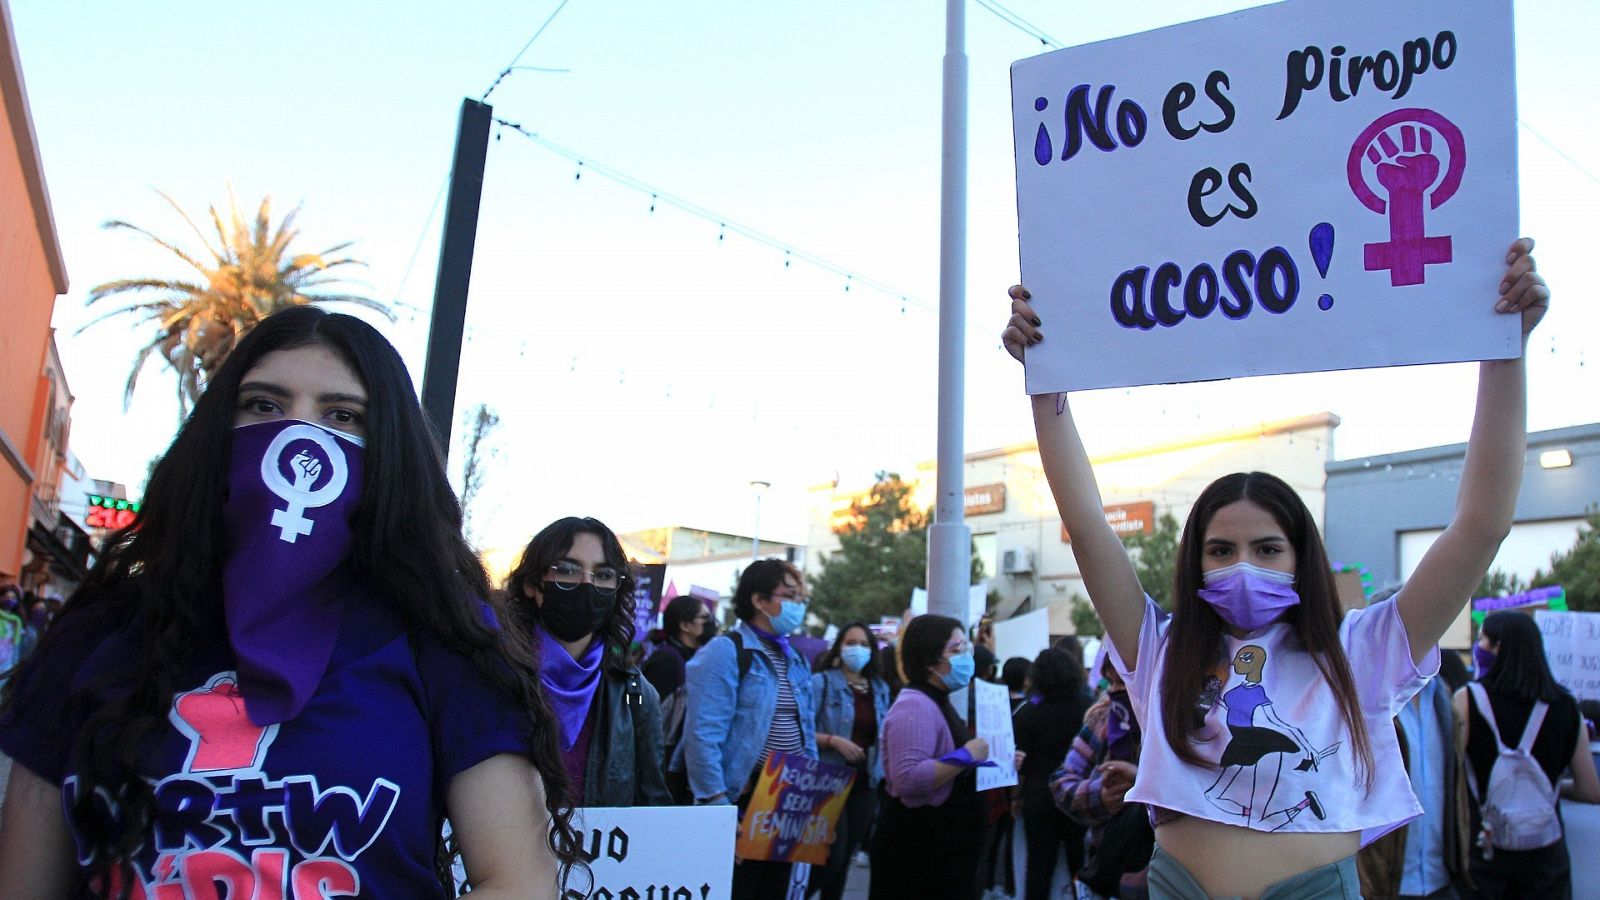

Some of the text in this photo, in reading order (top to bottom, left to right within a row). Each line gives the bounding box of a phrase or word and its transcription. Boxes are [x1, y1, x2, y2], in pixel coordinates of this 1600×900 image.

[1034, 30, 1457, 165] ¡No es piropo
[1187, 162, 1258, 227] es
[1110, 222, 1335, 330] acoso!
